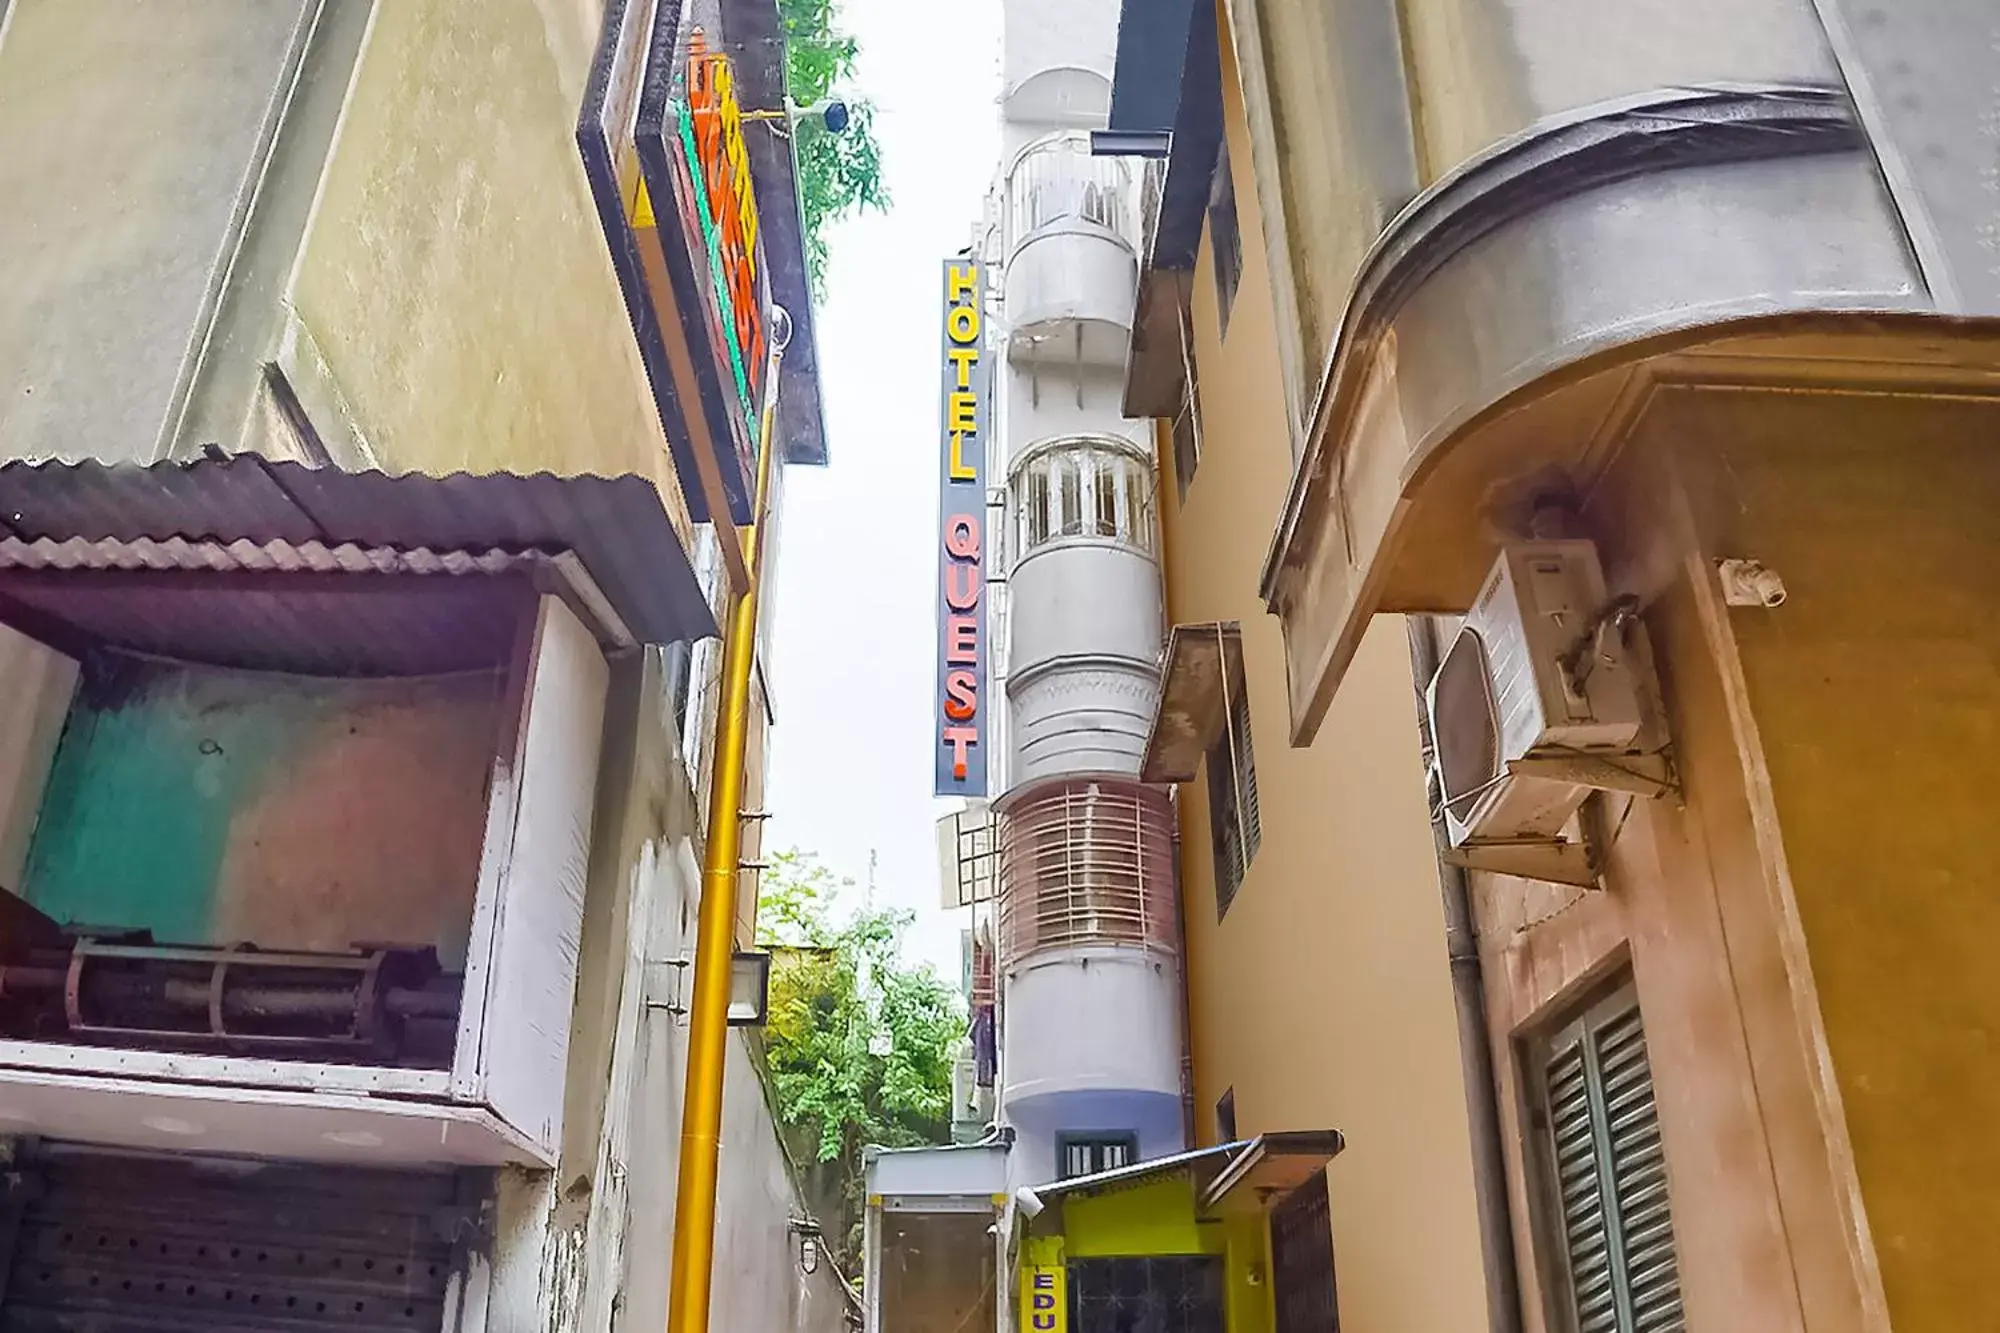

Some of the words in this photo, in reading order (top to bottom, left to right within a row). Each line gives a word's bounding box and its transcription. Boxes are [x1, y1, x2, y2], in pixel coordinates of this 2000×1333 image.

[947, 265, 979, 482] HOTEL
[943, 513, 980, 781] QUEST
[1033, 1273, 1055, 1331] EDU
